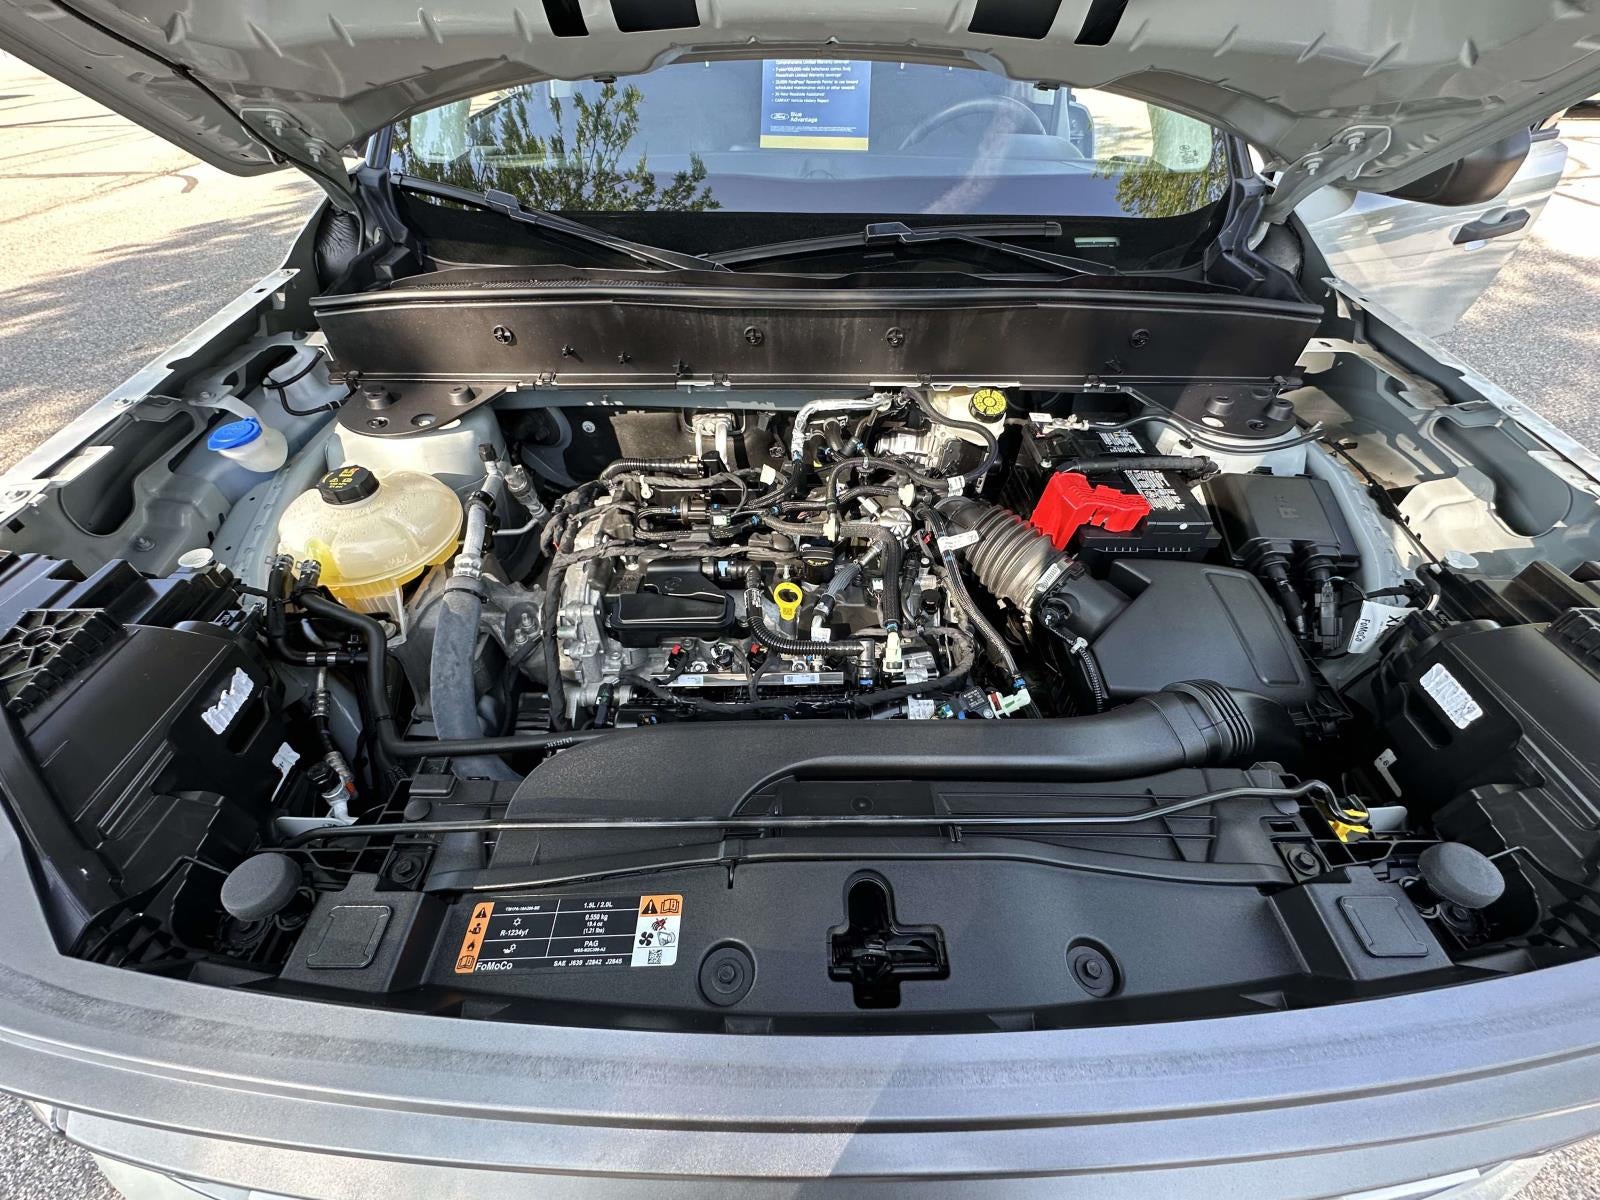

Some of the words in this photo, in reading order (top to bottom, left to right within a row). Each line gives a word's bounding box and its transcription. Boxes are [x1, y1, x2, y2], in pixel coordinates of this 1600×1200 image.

[585, 913, 600, 921] 0.550
[500, 928, 530, 937] R-1234yf
[475, 960, 513, 971] FoMoCo
